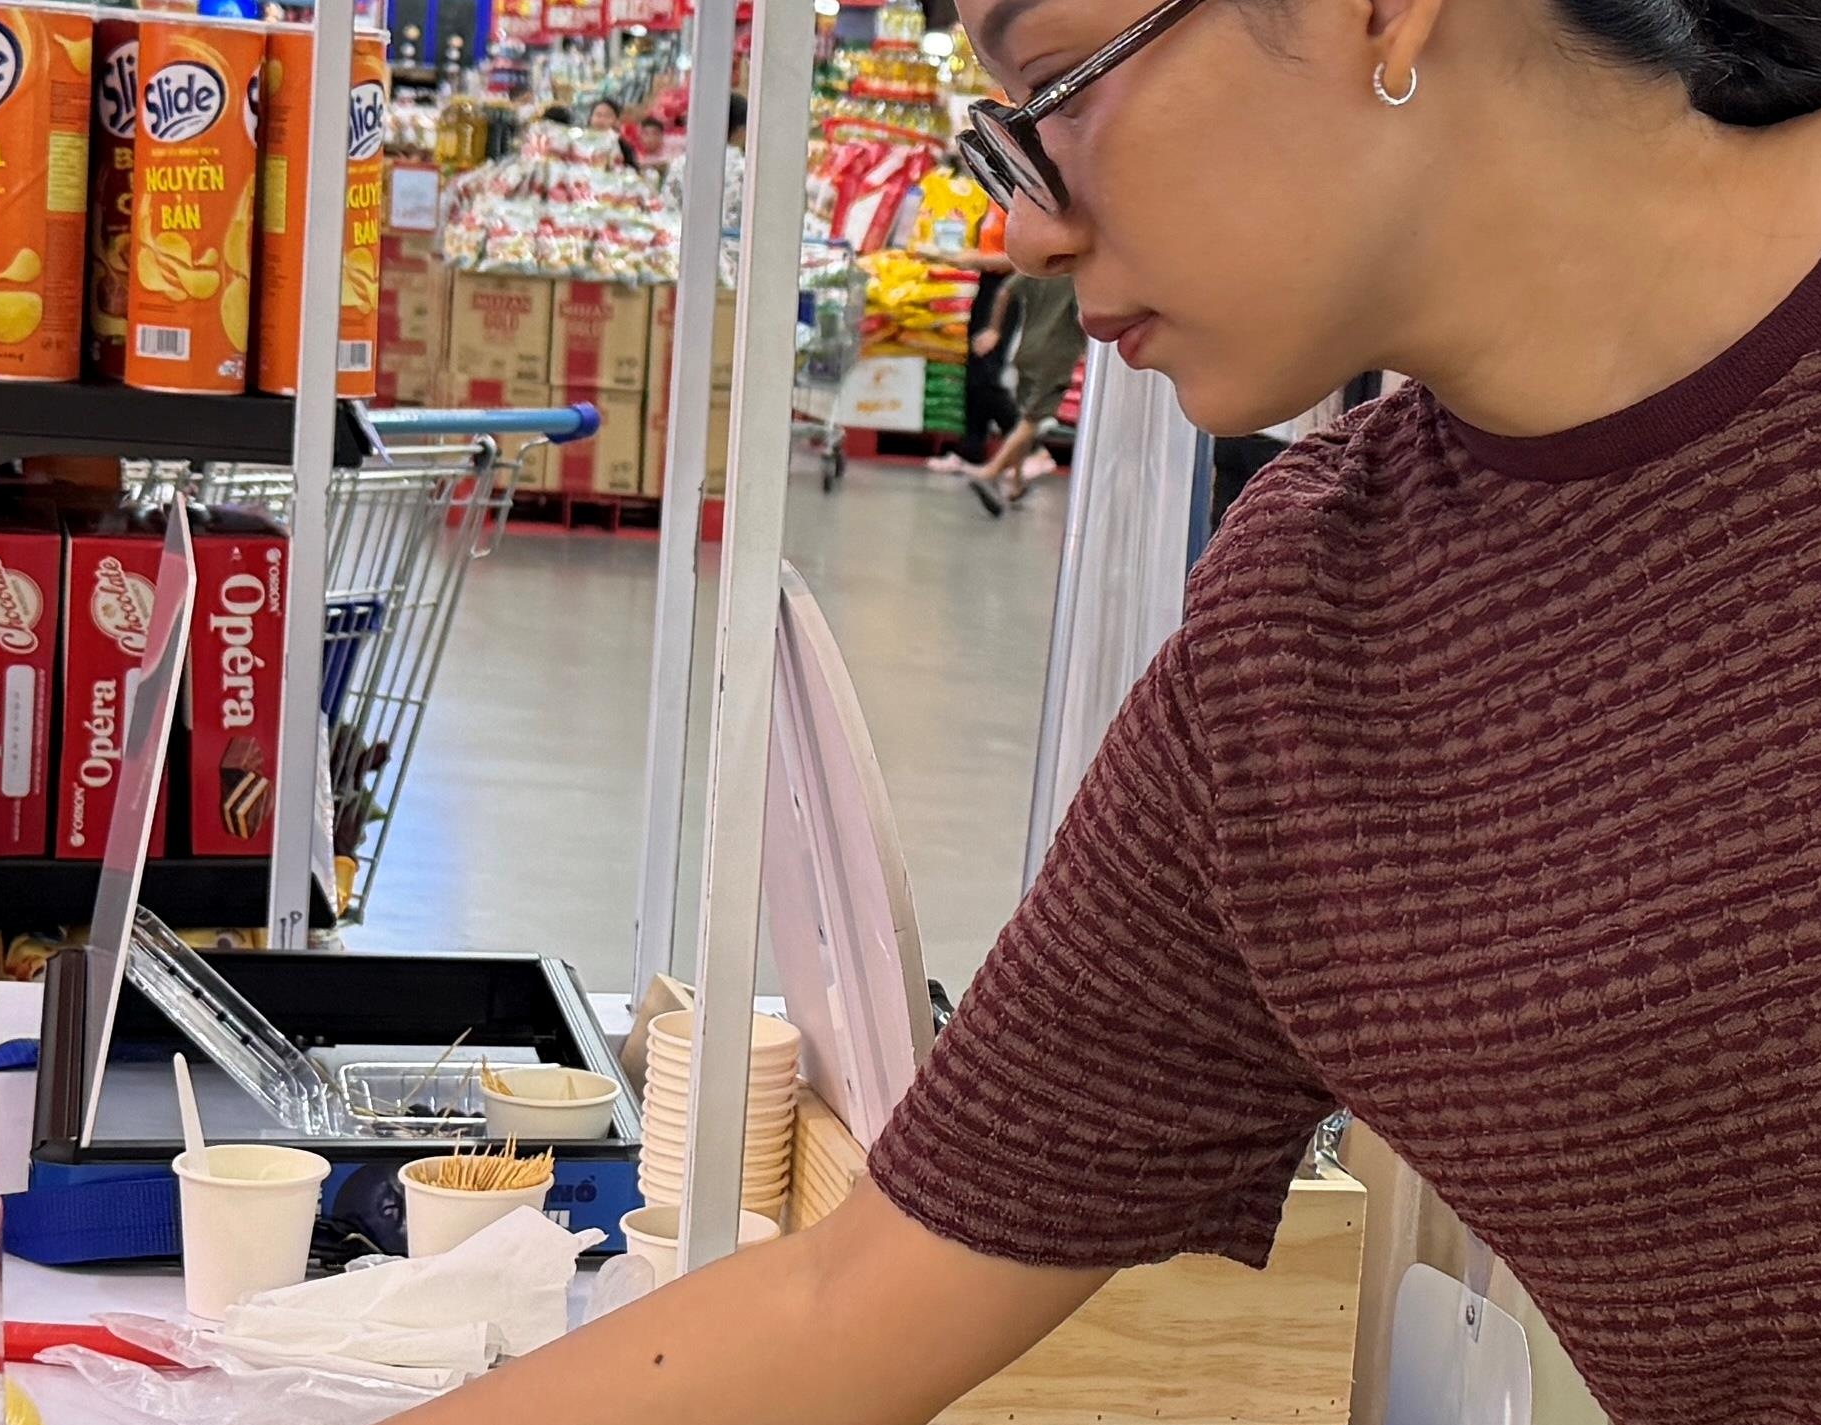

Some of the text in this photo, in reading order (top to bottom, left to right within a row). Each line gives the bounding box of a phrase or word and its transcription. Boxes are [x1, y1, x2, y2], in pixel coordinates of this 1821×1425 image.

[102, 53, 137, 130] Sli
[143, 72, 216, 135] Slide
[145, 158, 225, 192] NGUYÊN
[161, 194, 202, 231] BẢN
[209, 573, 266, 731] Opéra
[78, 677, 125, 789] Opéra
